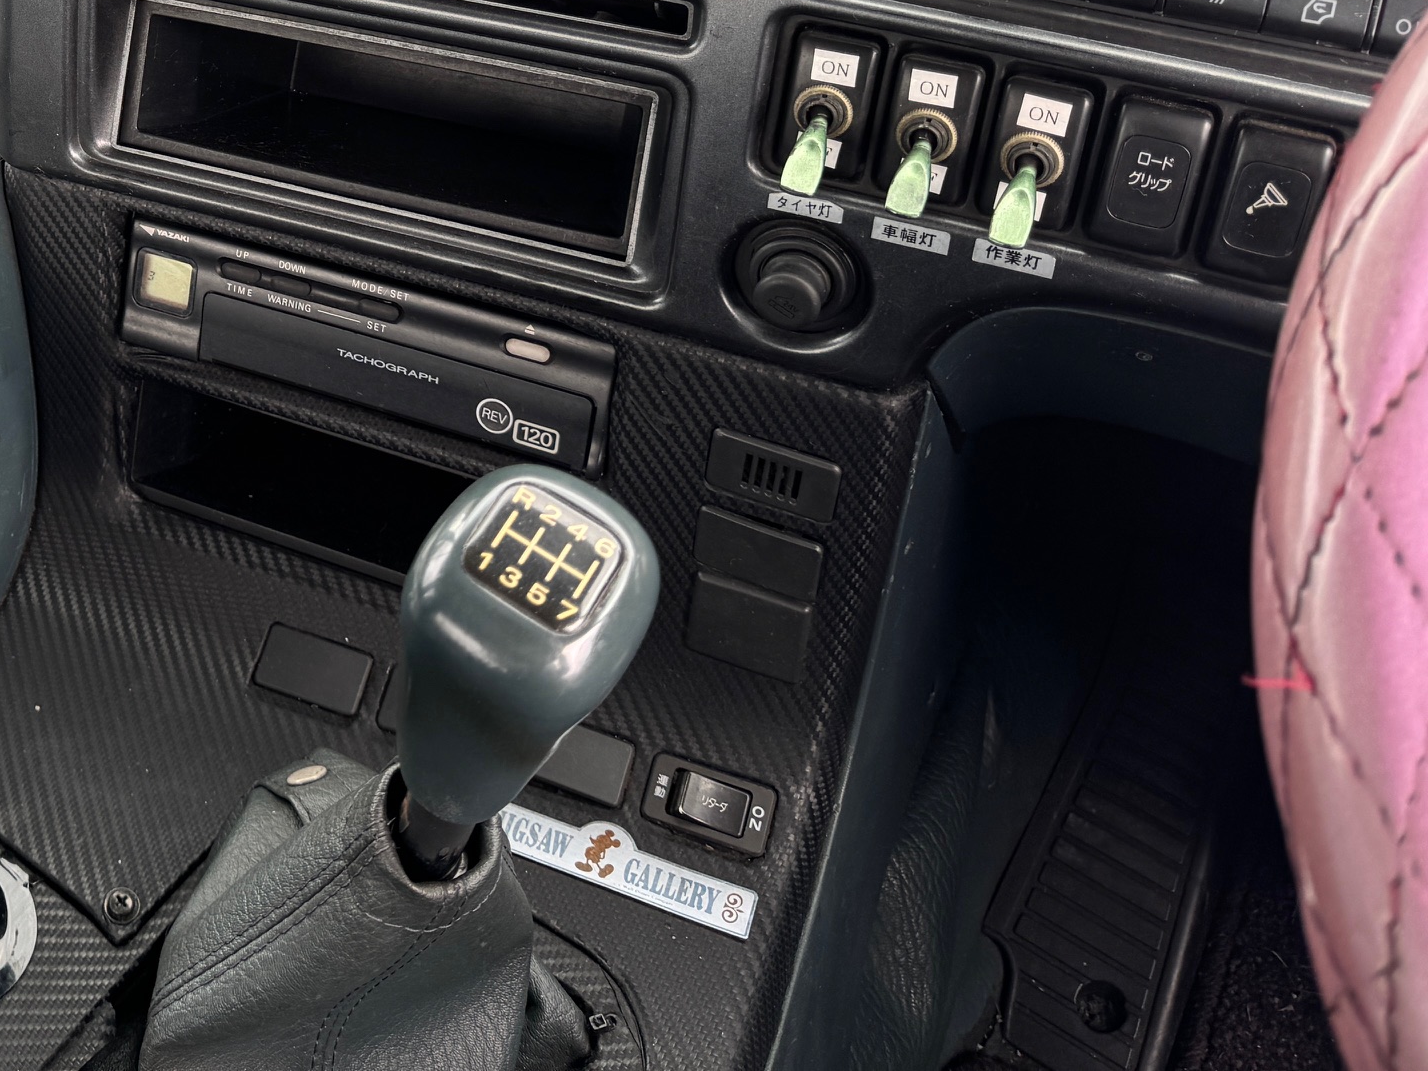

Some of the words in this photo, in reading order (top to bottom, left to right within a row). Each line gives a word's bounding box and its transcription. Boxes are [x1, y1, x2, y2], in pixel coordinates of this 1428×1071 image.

[821, 60, 850, 78] ON
[920, 80, 950, 99] ON
[1029, 106, 1060, 126] ON
[1137, 151, 1175, 171] ロード
[1128, 171, 1173, 192] グリップ
[777, 195, 833, 218] タイヤ灯
[156, 228, 190, 243] YAZAKI
[881, 224, 937, 248] 車幅灯
[235, 249, 250, 259] UP
[985, 245, 1042, 270] 作業灯
[278, 260, 306, 275] DOWN
[226, 282, 253, 297] TIME
[351, 279, 410, 302] MODE/SET
[267, 294, 312, 313] WARNING
[366, 320, 387, 333] SET
[337, 348, 439, 385] TACHOGRAPH
[481, 407, 508, 425] REV
[520, 426, 554, 448] 120
[511, 486, 537, 511] R
[539, 504, 562, 526] 2
[566, 523, 589, 541] 4
[594, 537, 617, 559] 6
[478, 551, 494, 570] 1
[498, 566, 523, 589] 3
[526, 582, 551, 606] 5
[556, 599, 579, 620] 7
[748, 805, 765, 832] ON
[501, 811, 575, 859] IGSAW
[623, 858, 722, 915] GALLERY
